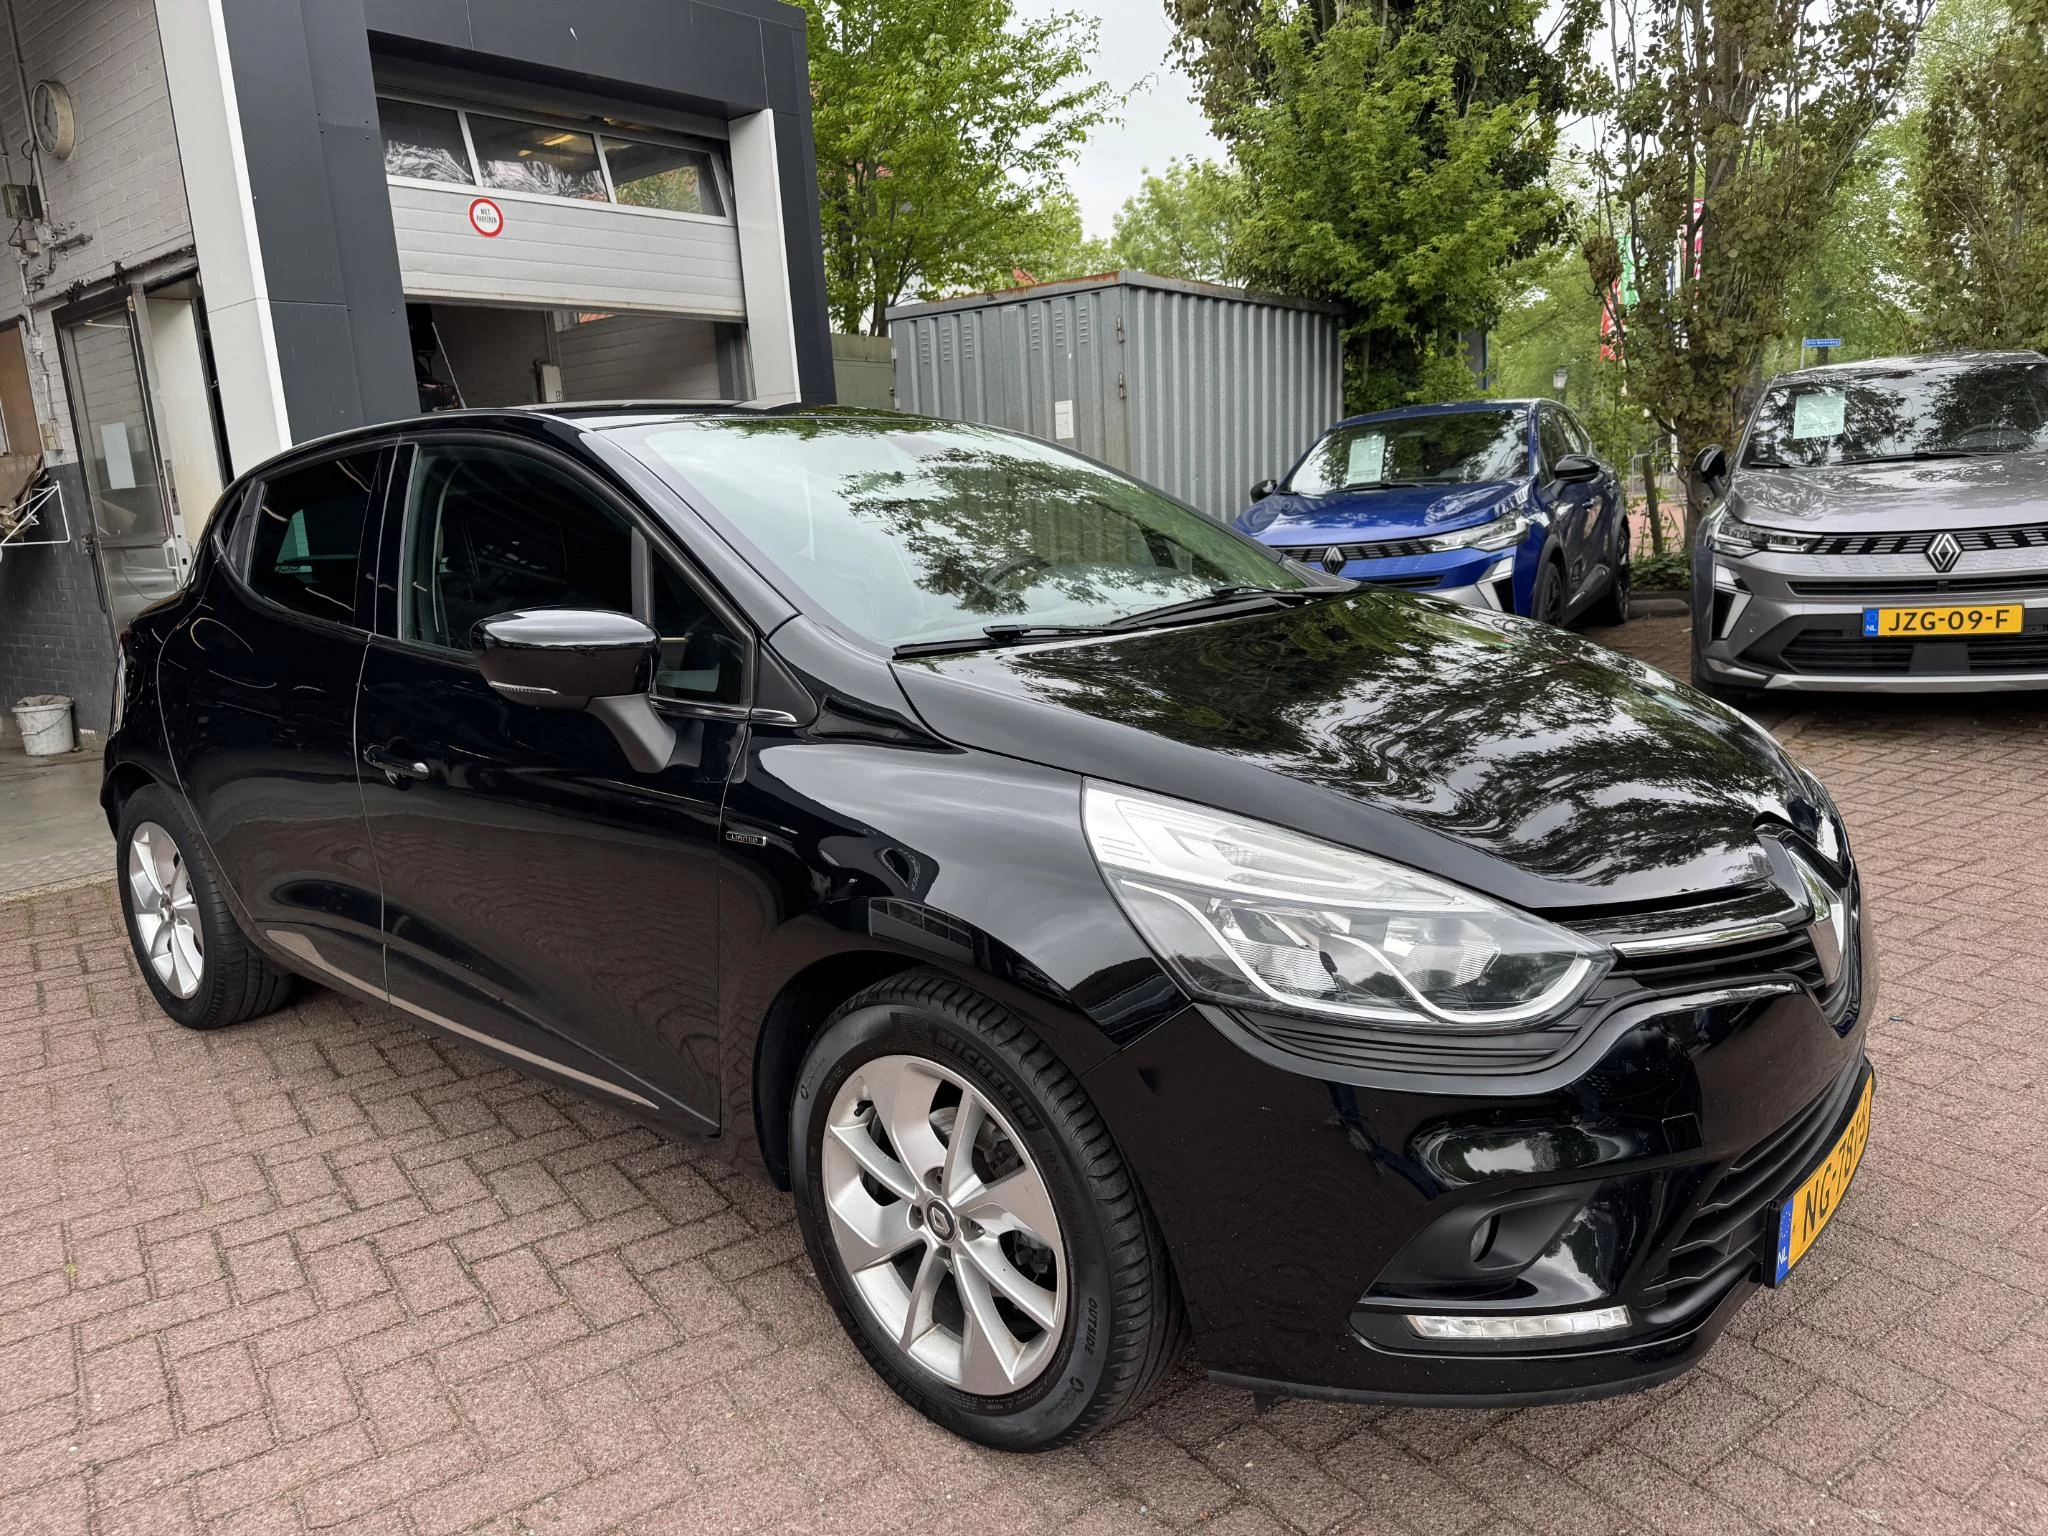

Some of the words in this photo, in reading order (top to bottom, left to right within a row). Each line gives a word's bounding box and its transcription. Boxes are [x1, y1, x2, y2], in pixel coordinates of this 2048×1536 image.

[1865, 624, 1877, 632] NL
[1888, 609, 2010, 632] JZG-09-F
[935, 1029, 1038, 1127] MICHELIN
[1777, 1246, 1788, 1267] NL
[1084, 1296, 1098, 1357] OUTSIDE
